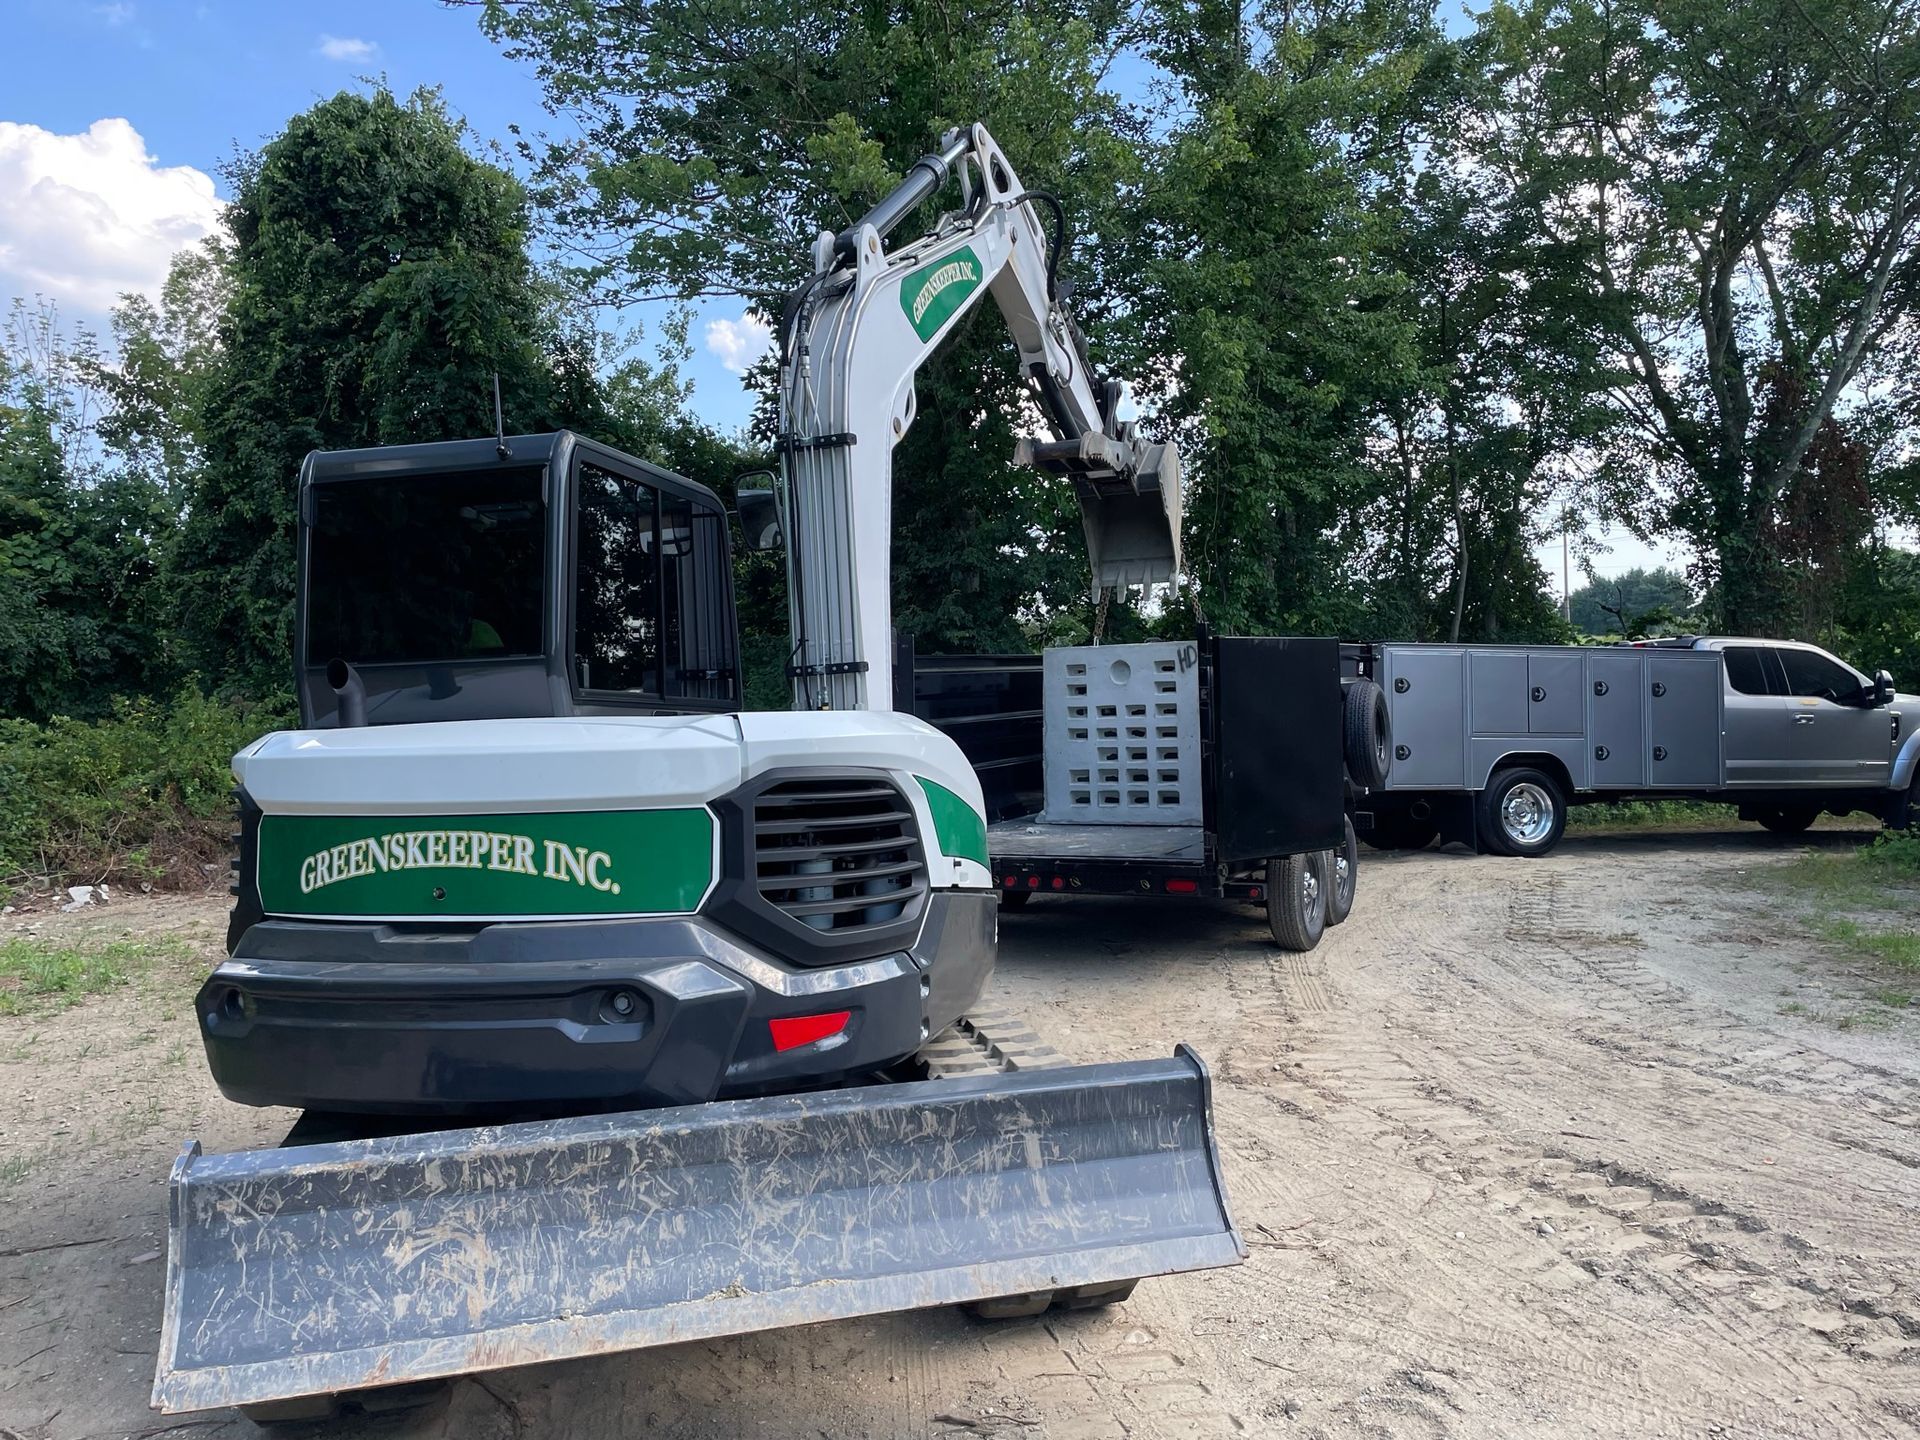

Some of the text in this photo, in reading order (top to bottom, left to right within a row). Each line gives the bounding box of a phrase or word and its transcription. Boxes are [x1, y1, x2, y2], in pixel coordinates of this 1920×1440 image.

[1177, 645, 1197, 673] HD
[300, 831, 621, 894] GREENSKEEPER INC.
